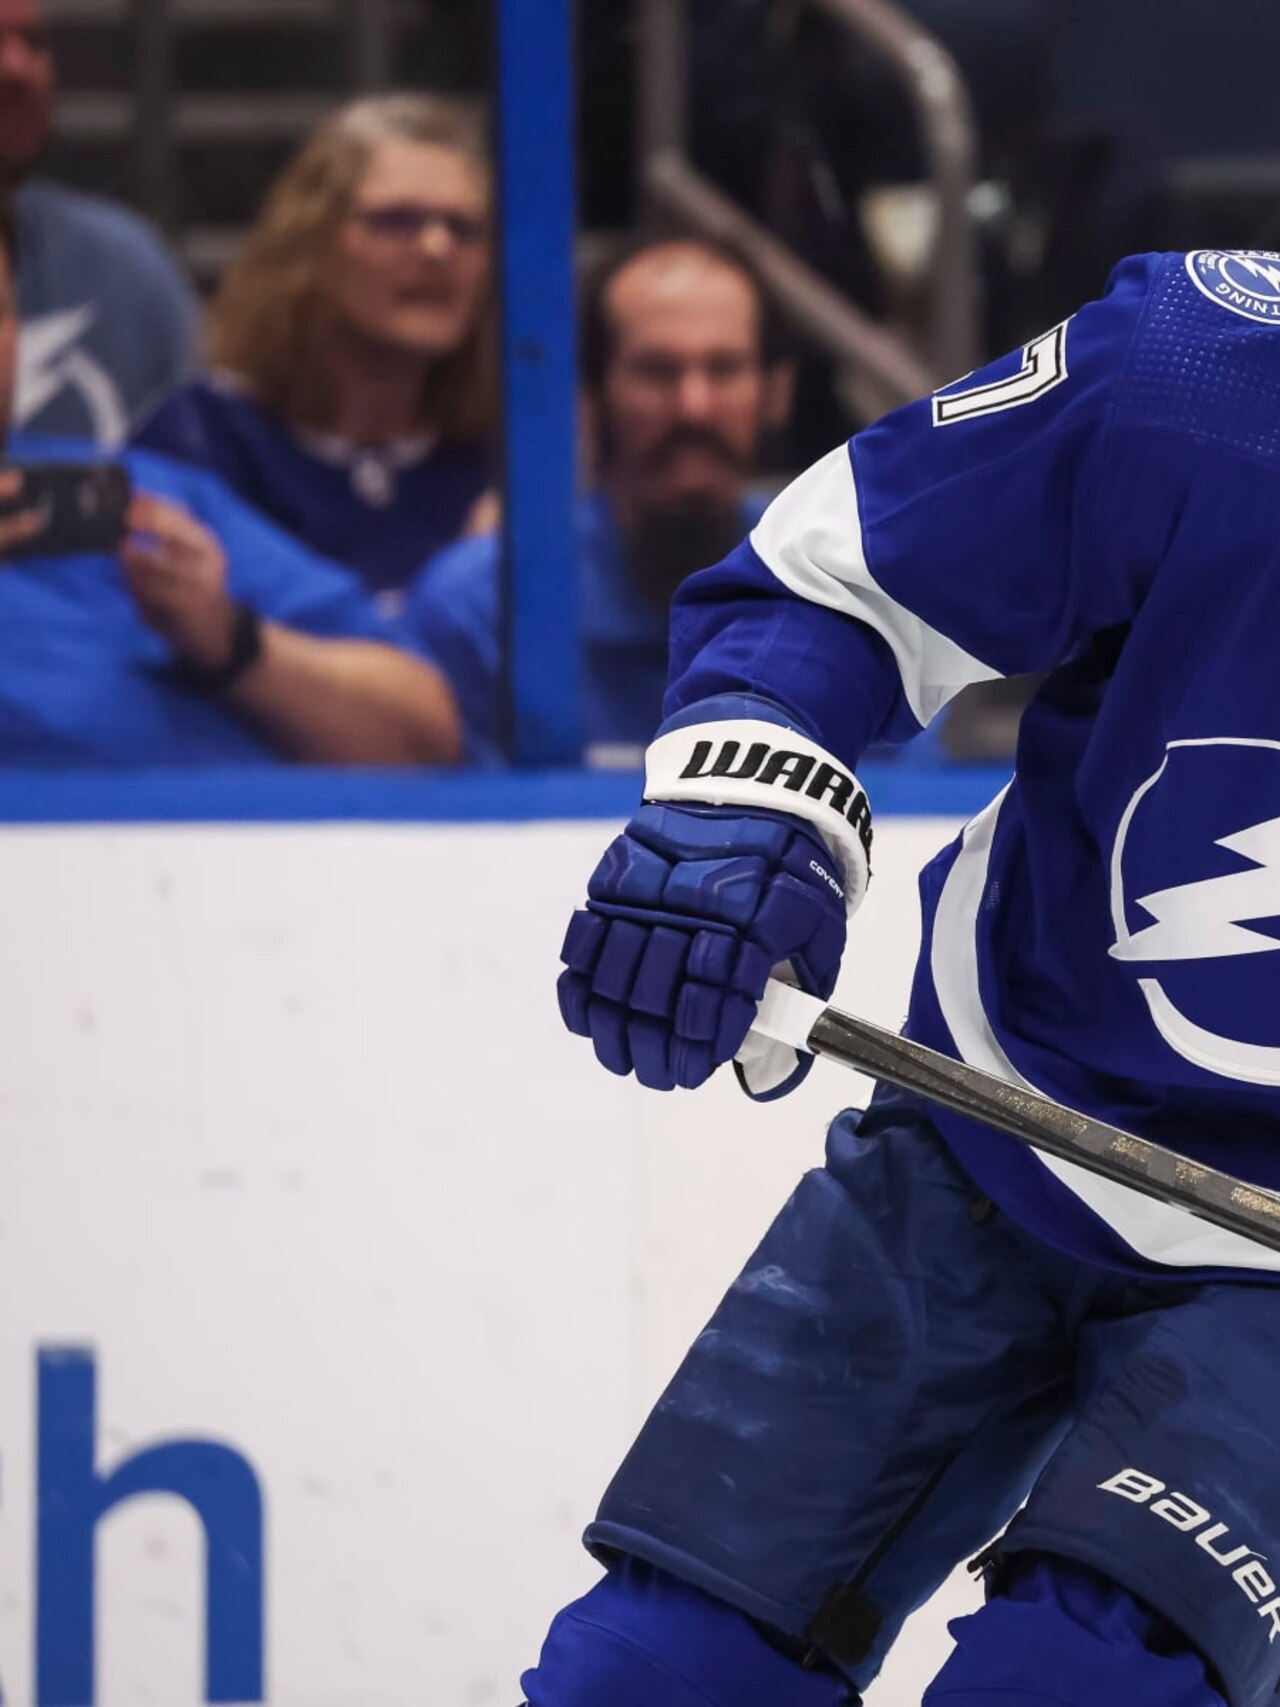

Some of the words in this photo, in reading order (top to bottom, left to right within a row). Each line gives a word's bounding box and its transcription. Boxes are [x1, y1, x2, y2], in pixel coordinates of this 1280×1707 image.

[931, 314, 1072, 428] 7
[679, 740, 873, 862] WARR
[809, 859, 845, 898] COVERT
[0, 1341, 266, 1705] h
